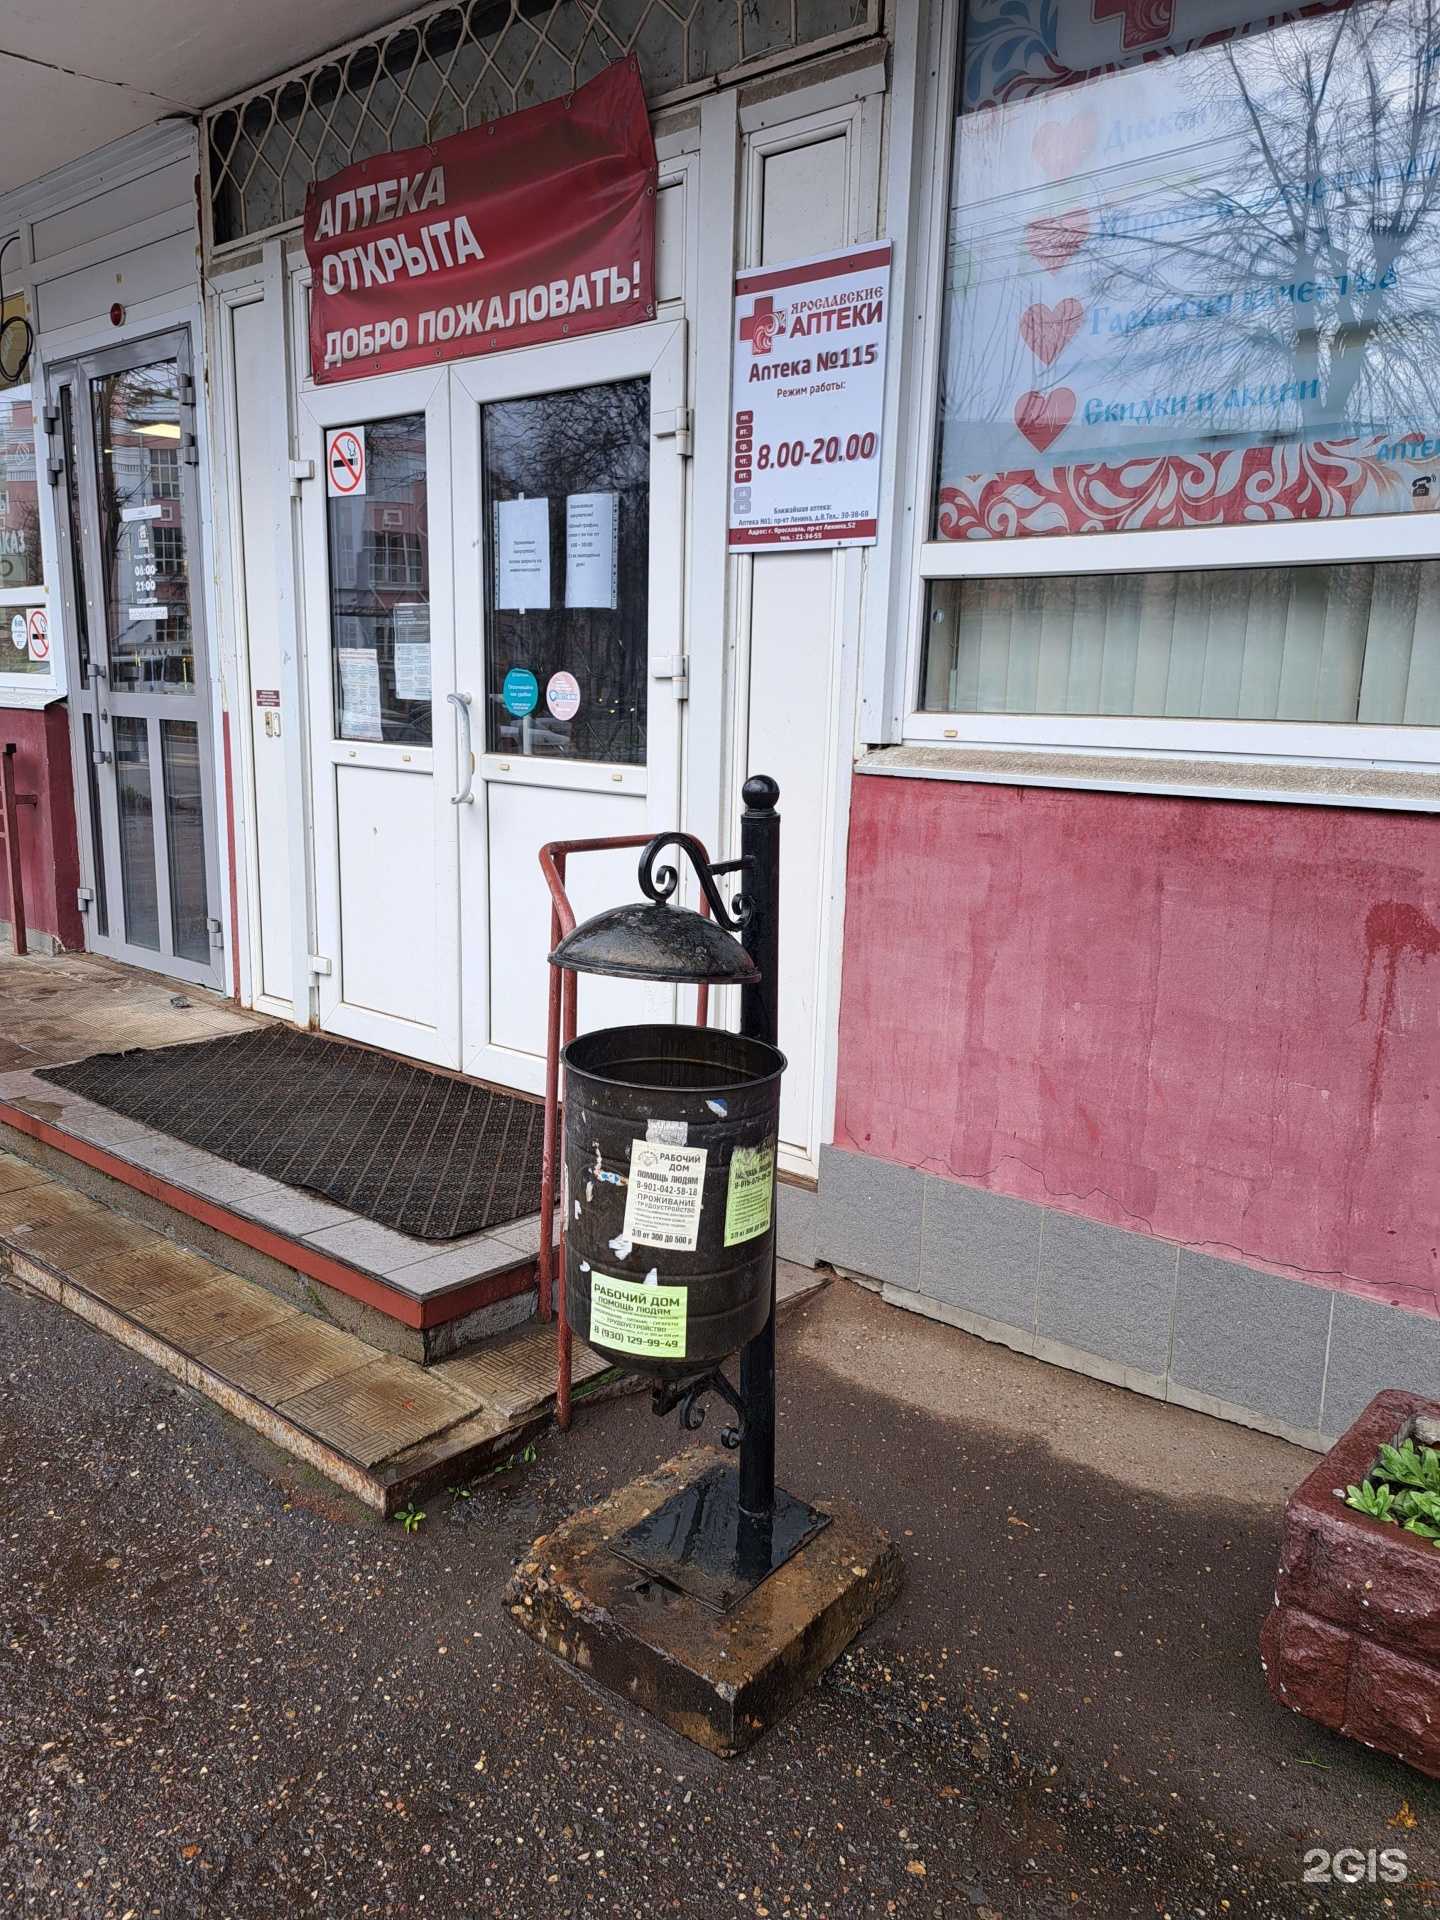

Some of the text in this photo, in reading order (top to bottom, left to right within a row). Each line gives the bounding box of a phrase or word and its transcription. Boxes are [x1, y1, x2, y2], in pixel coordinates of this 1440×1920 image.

[314, 166, 446, 241] АПТЕКА
[322, 216, 485, 296] ОТКРЫТА
[791, 286, 884, 315] ЯРОСЛАВСКИЕ
[323, 261, 641, 370] ДОБРО ПОЖАЛОВАТЬ!
[789, 300, 884, 339] АПТЕКИ
[748, 343, 878, 383] Аптека №115
[777, 380, 846, 398] Режим работы:
[1083, 395, 1187, 426] Скидки
[757, 431, 876, 470] 8.00-20.00
[659, 1152, 701, 1163] РАБОЧИЙ
[669, 1163, 690, 1172] ДОМ
[637, 1169, 699, 1185] ПОМОЩЬ ЛЮДЯМ
[637, 1193, 697, 1207] ПРОЖИВАНИЕ
[594, 1283, 680, 1308] РАБОЧИЙ ДОМ
[598, 1295, 634, 1312] ПОМОЩЬ
[636, 1306, 671, 1315] ЛЮДЯМ
[601, 1328, 624, 1343] (930)
